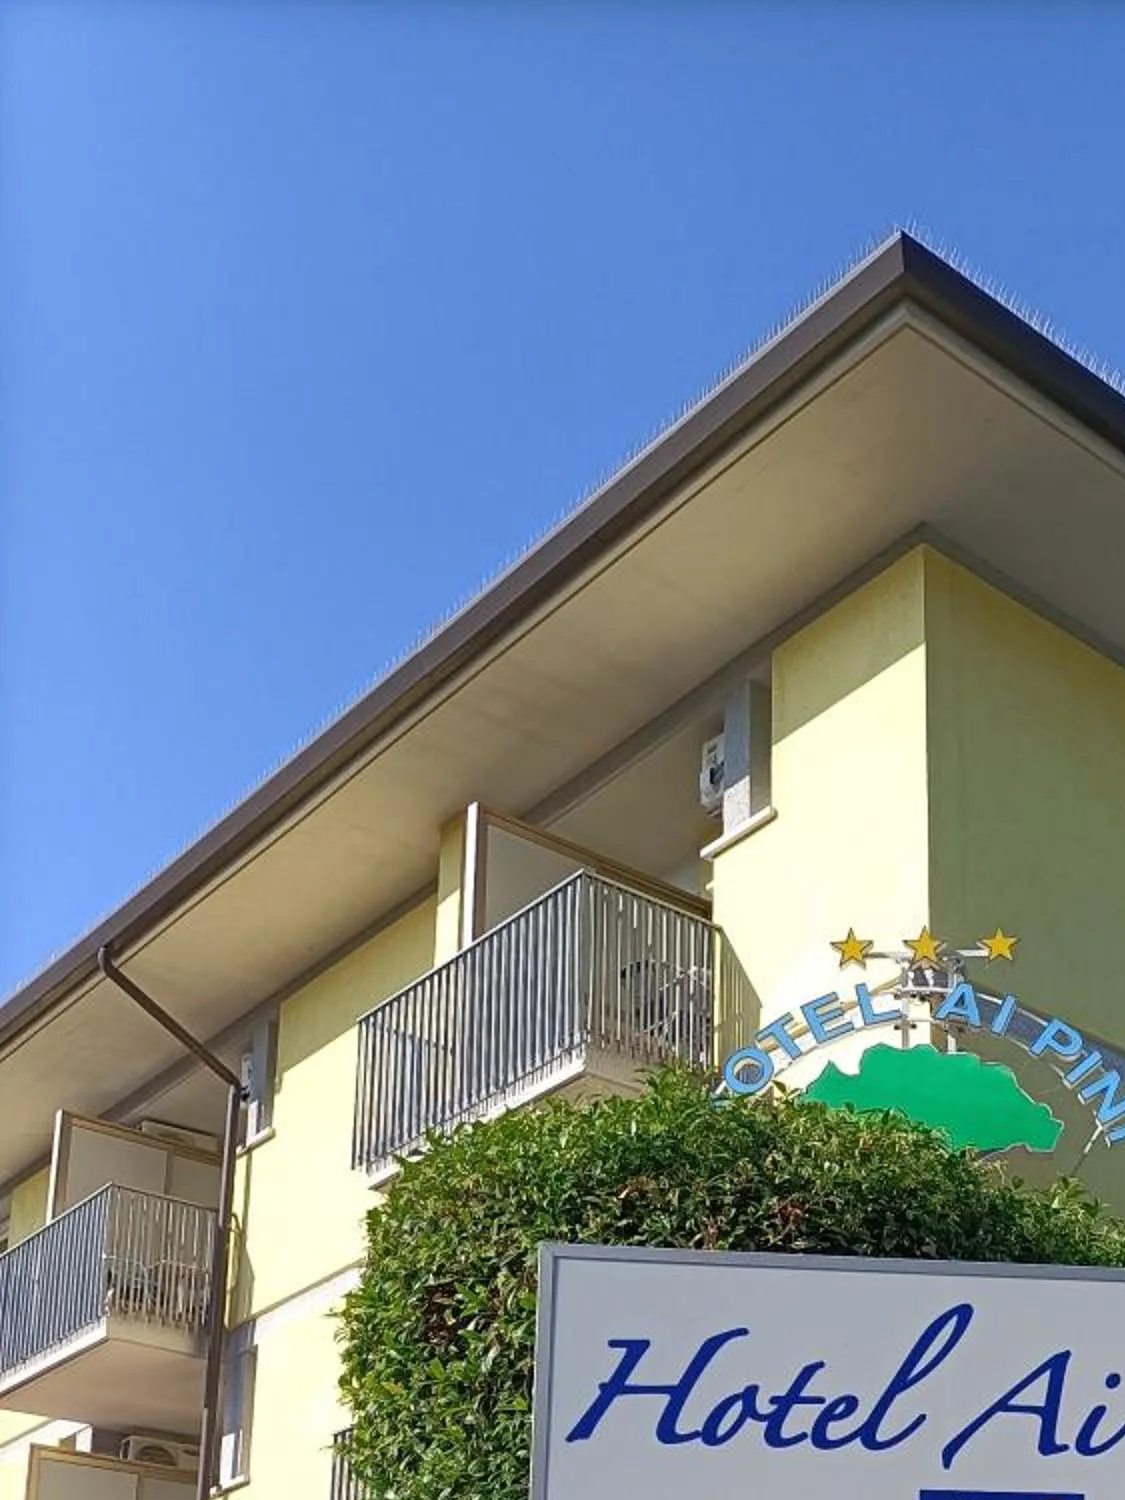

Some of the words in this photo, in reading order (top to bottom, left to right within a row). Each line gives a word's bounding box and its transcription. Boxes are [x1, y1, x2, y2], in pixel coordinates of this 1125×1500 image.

[710, 982, 901, 1110] OTEL
[936, 982, 1018, 1037] AI
[566, 1302, 976, 1452] Hotel
